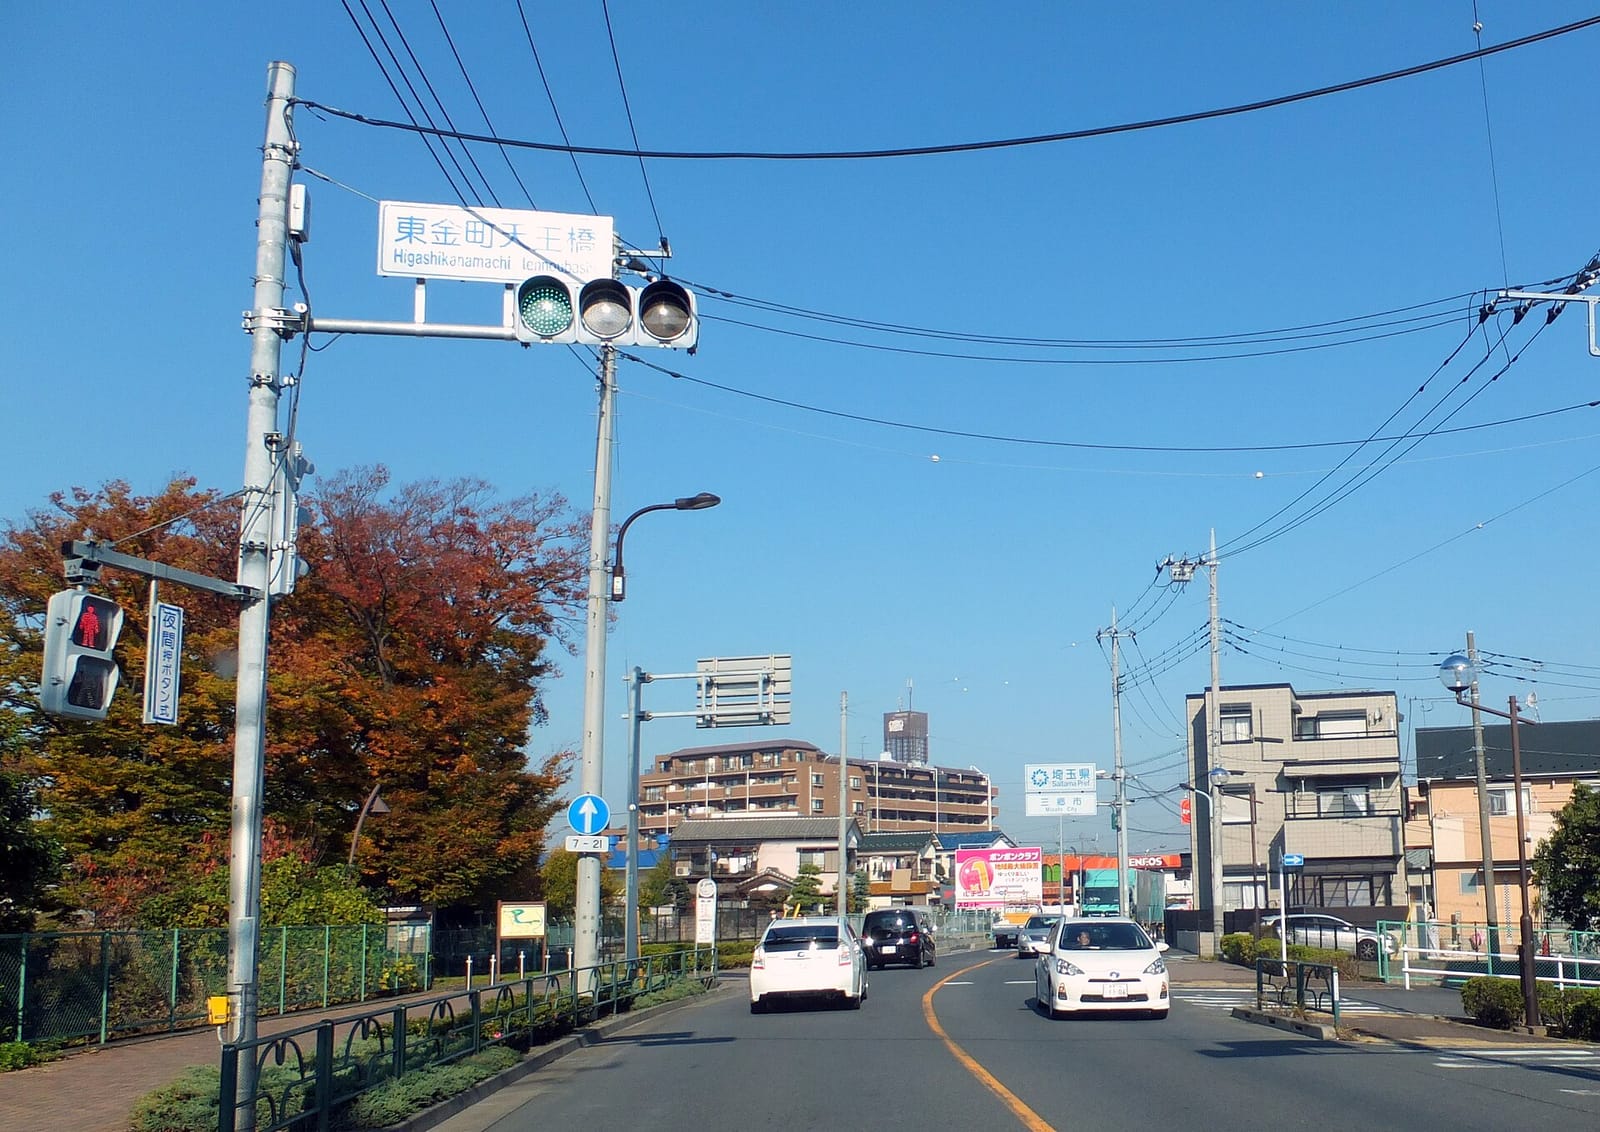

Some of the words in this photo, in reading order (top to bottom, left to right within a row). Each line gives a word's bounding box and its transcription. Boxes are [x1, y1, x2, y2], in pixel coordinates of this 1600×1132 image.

[394, 215, 596, 253] 東金町天王橋
[393, 248, 511, 270] Higashikanamachi
[1128, 857, 1163, 867] ENEOS
